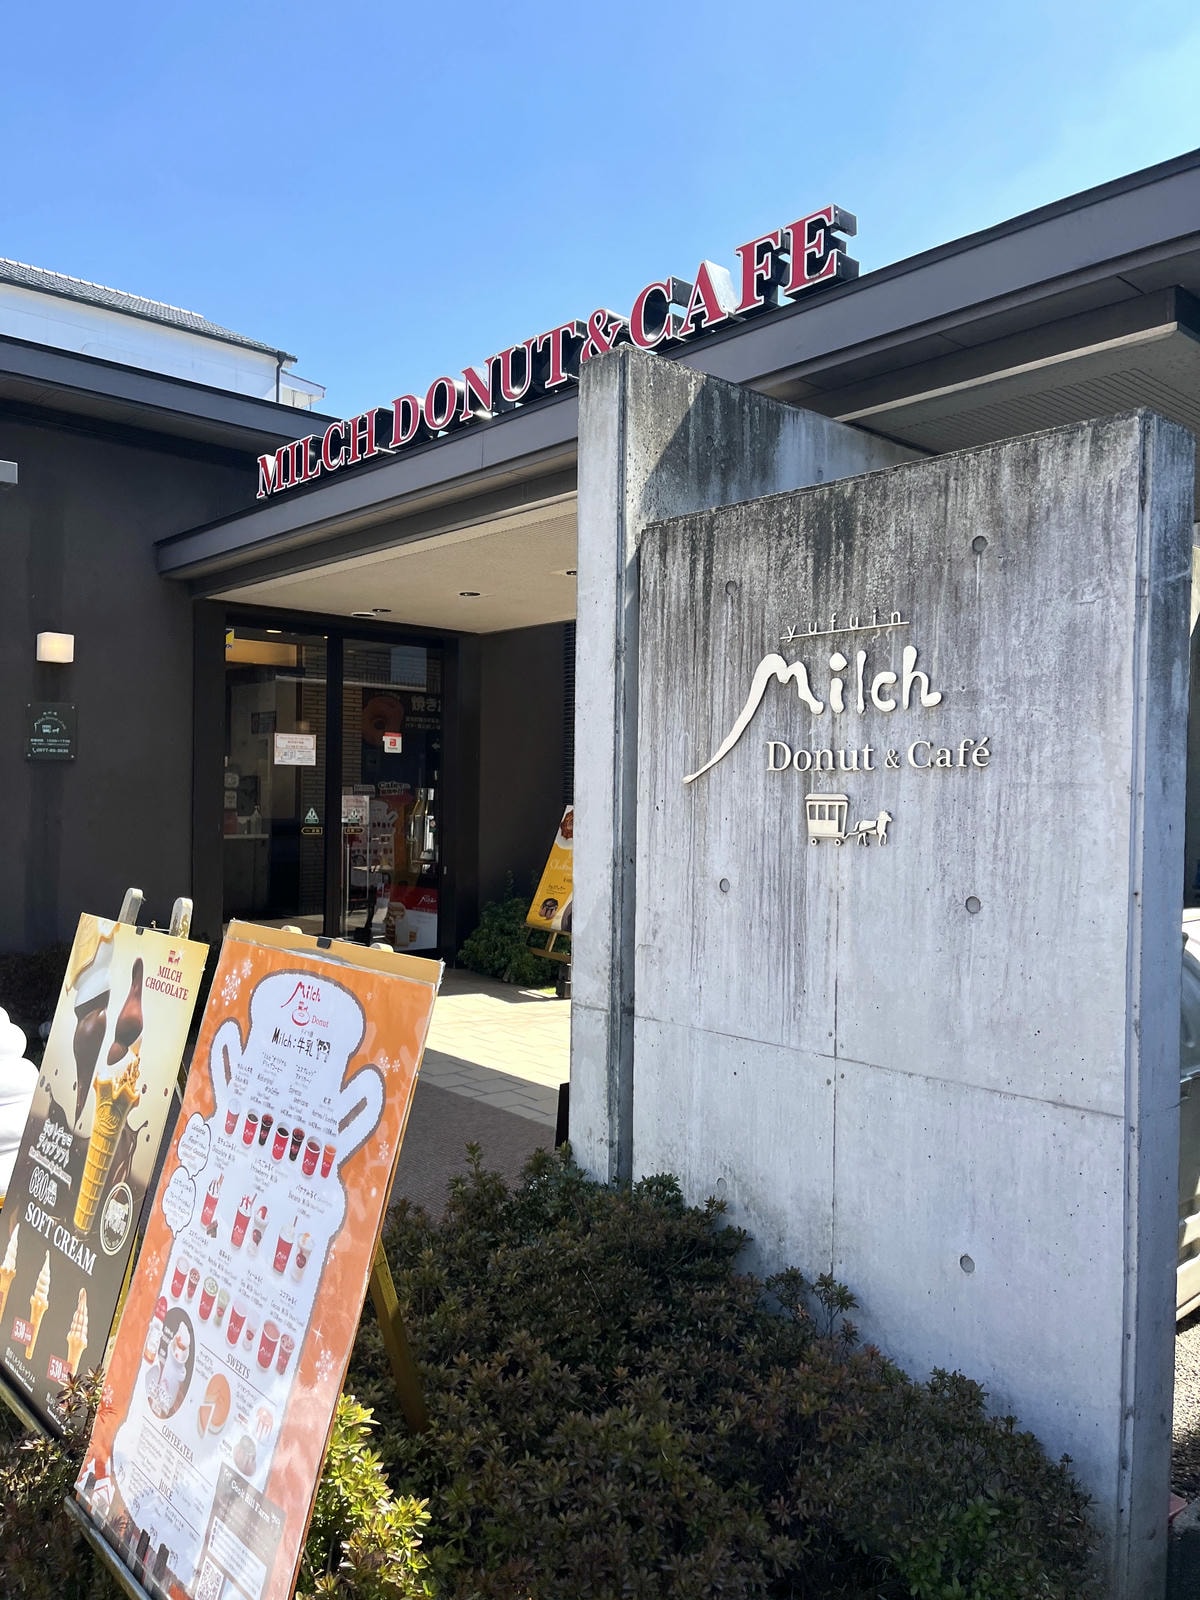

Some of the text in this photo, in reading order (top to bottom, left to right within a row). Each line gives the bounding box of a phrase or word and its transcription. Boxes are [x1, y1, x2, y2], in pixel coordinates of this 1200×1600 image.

[256, 407, 385, 500] MILCH
[786, 610, 902, 642] yufuin
[682, 645, 942, 784] Milch
[766, 737, 991, 772] Donut & Café
[158, 965, 183, 983] MILCH
[145, 976, 189, 1001] CHOCOLATE
[280, 981, 321, 1008] Milch
[311, 1015, 330, 1028] Donut
[25, 1201, 54, 1239] SOFT
[53, 1225, 97, 1276] CREAM
[50, 1359, 62, 1378] 530
[226, 1353, 251, 1379] SWEETS
[158, 1478, 173, 1501] JUICE
[231, 1480, 246, 1500] Cook
[254, 1502, 271, 1522] Farm
